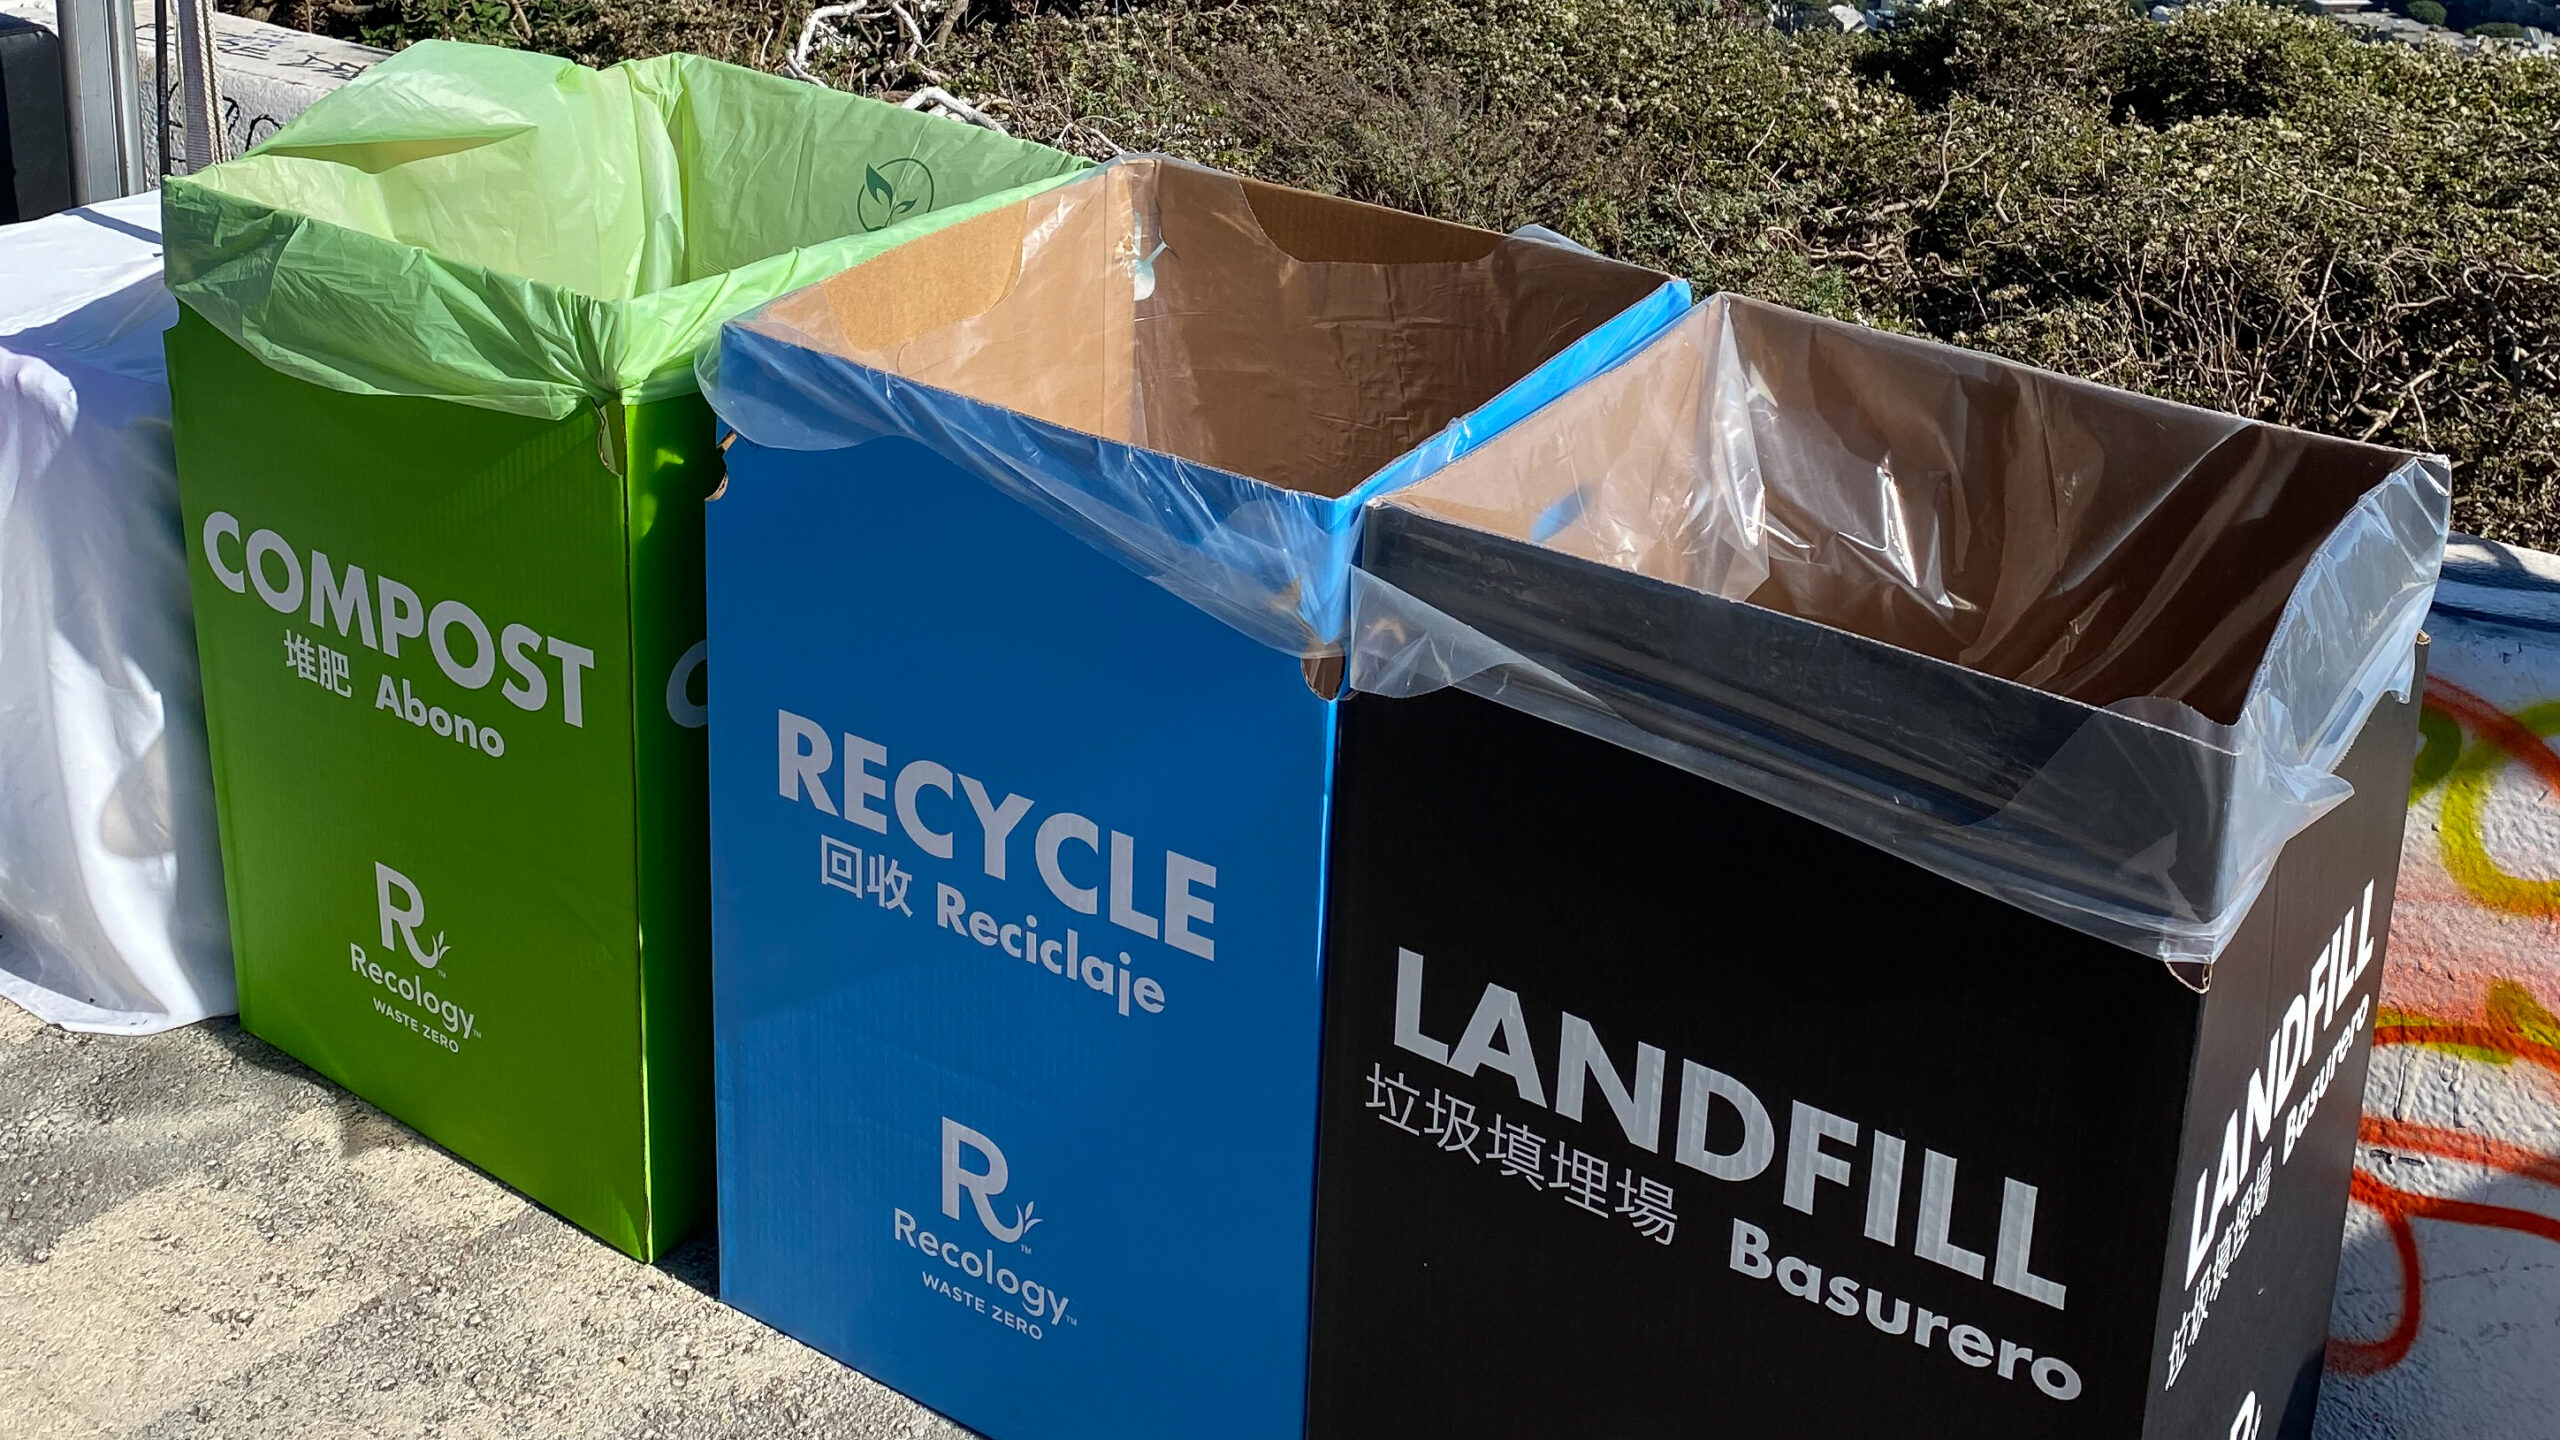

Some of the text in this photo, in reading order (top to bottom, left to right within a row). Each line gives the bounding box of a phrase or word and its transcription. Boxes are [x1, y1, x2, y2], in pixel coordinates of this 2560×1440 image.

[202, 511, 595, 729] COMPOST
[283, 628, 353, 699] 堆肥
[375, 674, 506, 758] Abono
[777, 708, 1218, 962] RECYCLE
[820, 834, 914, 917] 回收
[349, 941, 475, 1040] Recology
[936, 881, 1166, 1018] Reciclaje
[372, 996, 460, 1054] WASTE ZERO
[2184, 878, 2376, 1292] LANDFILL
[2282, 993, 2371, 1166] Basurero
[1364, 1062, 1679, 1246] 垃圾填埋場
[1393, 946, 2068, 1312] LANDFILL
[894, 1207, 1070, 1327] Recology
[921, 1271, 1044, 1341] WASTE ZERO
[1729, 1217, 2083, 1402] Basurero
